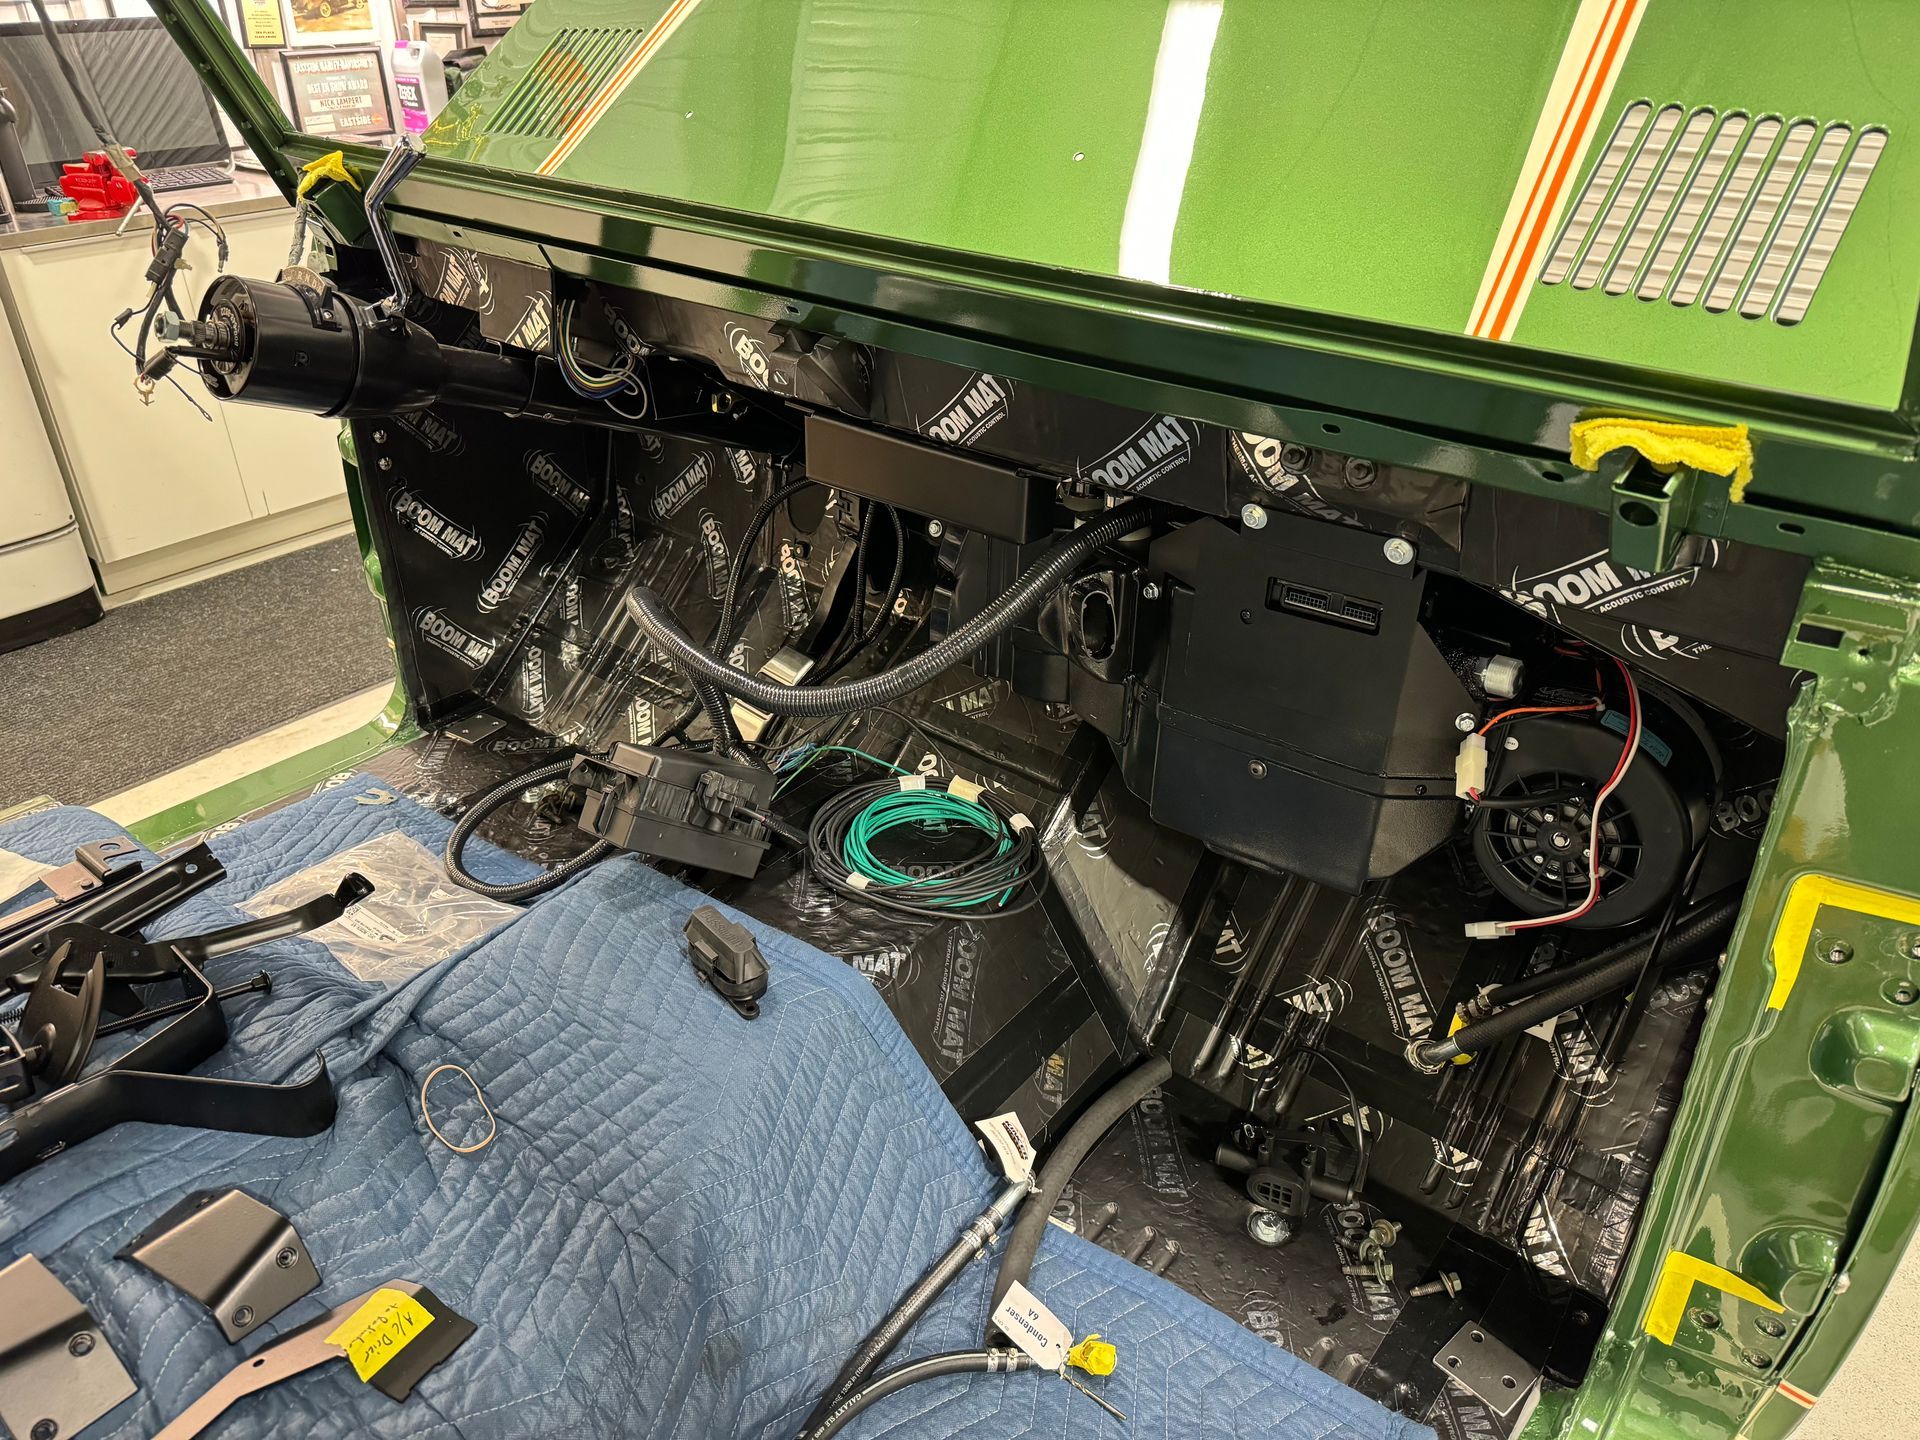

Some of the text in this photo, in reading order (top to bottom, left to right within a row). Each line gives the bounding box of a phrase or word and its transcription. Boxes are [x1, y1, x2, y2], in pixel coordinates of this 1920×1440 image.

[340, 115, 372, 127] EASTSIDE
[446, 254, 466, 292] MAT
[522, 298, 550, 346] MAT
[929, 374, 1006, 442] OOM MAT
[966, 411, 1006, 446] ACOUSTIC CONTROL
[421, 418, 458, 450] MAT
[1092, 416, 1190, 488] OOM MAT
[530, 454, 592, 512] BOOM MA
[654, 481, 688, 516] BOOM
[684, 455, 708, 488] MAT
[1136, 456, 1188, 492] ACOUSTIC CONTROL
[394, 492, 445, 535] BOOM
[441, 526, 478, 556] MAT
[702, 517, 726, 570] BOOM
[482, 554, 522, 604] BOOM
[516, 520, 543, 556] MAT
[1532, 560, 1622, 606] OOM
[1600, 578, 1690, 614] ACOUSTIC CONTROL
[419, 611, 495, 666] BOOM MAT
[636, 697, 652, 737] OOM
[1216, 920, 1242, 954] AT
[1368, 911, 1416, 990] BOOM
[852, 952, 906, 978] MAT
[1374, 969, 1388, 1001] ACOUSTIC
[1386, 1002, 1400, 1033] CONTROL
[940, 1006, 967, 1066] MAT
[1006, 1306, 1048, 1348] Condenser
[1028, 1308, 1040, 1320] 6A
[364, 1311, 414, 1363] A/C Drier
[855, 1357, 871, 1378] (10mm)
[824, 1414, 836, 1428] SLE
[834, 1393, 862, 1419] GALAXY
[1441, 1409, 1456, 1440] CONTRO
